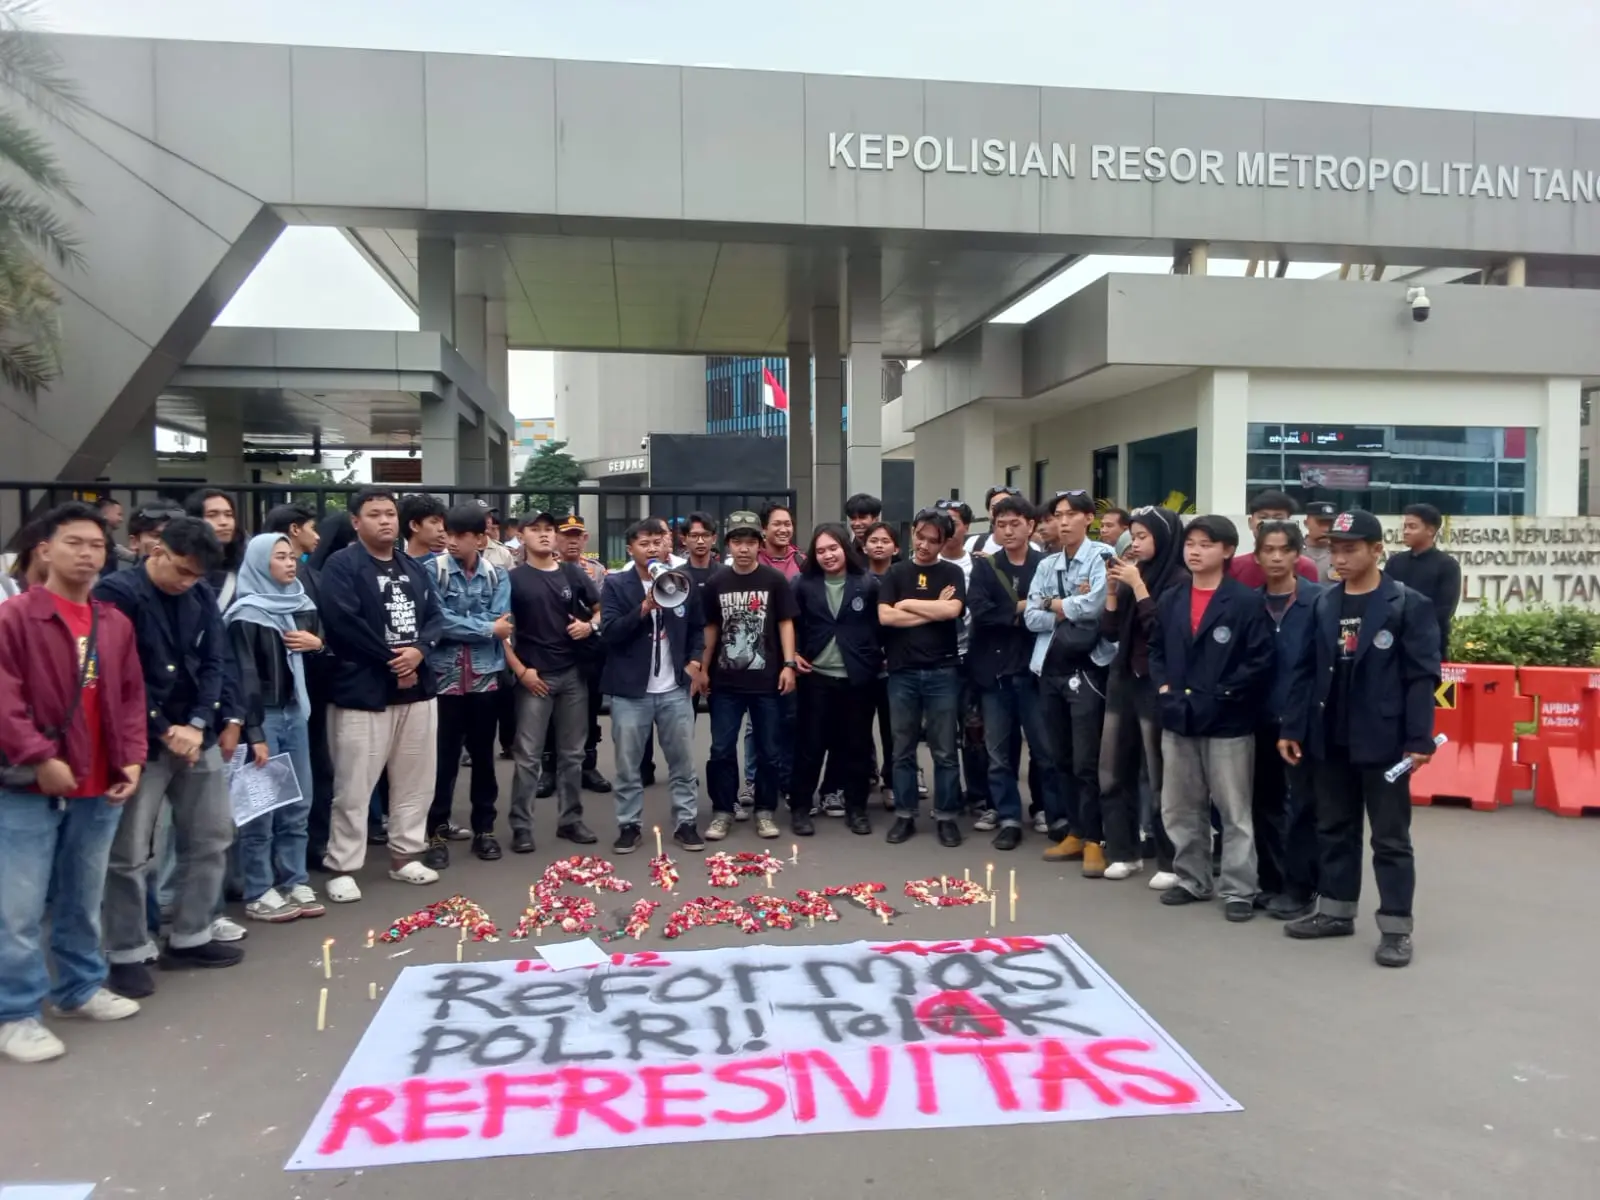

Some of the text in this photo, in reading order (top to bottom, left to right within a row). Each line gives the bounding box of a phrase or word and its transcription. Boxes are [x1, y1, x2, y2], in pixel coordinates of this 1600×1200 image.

[828, 132, 1076, 178] KEPOLISIAN
[1090, 145, 1225, 184] RESOR
[1236, 151, 1520, 199] METROPOLITAN
[1450, 528, 1510, 544] NEGARA
[1514, 527, 1584, 544] REPUBLIK
[1445, 550, 1547, 566] TROPOLITAN
[719, 591, 769, 608] HUMAN
